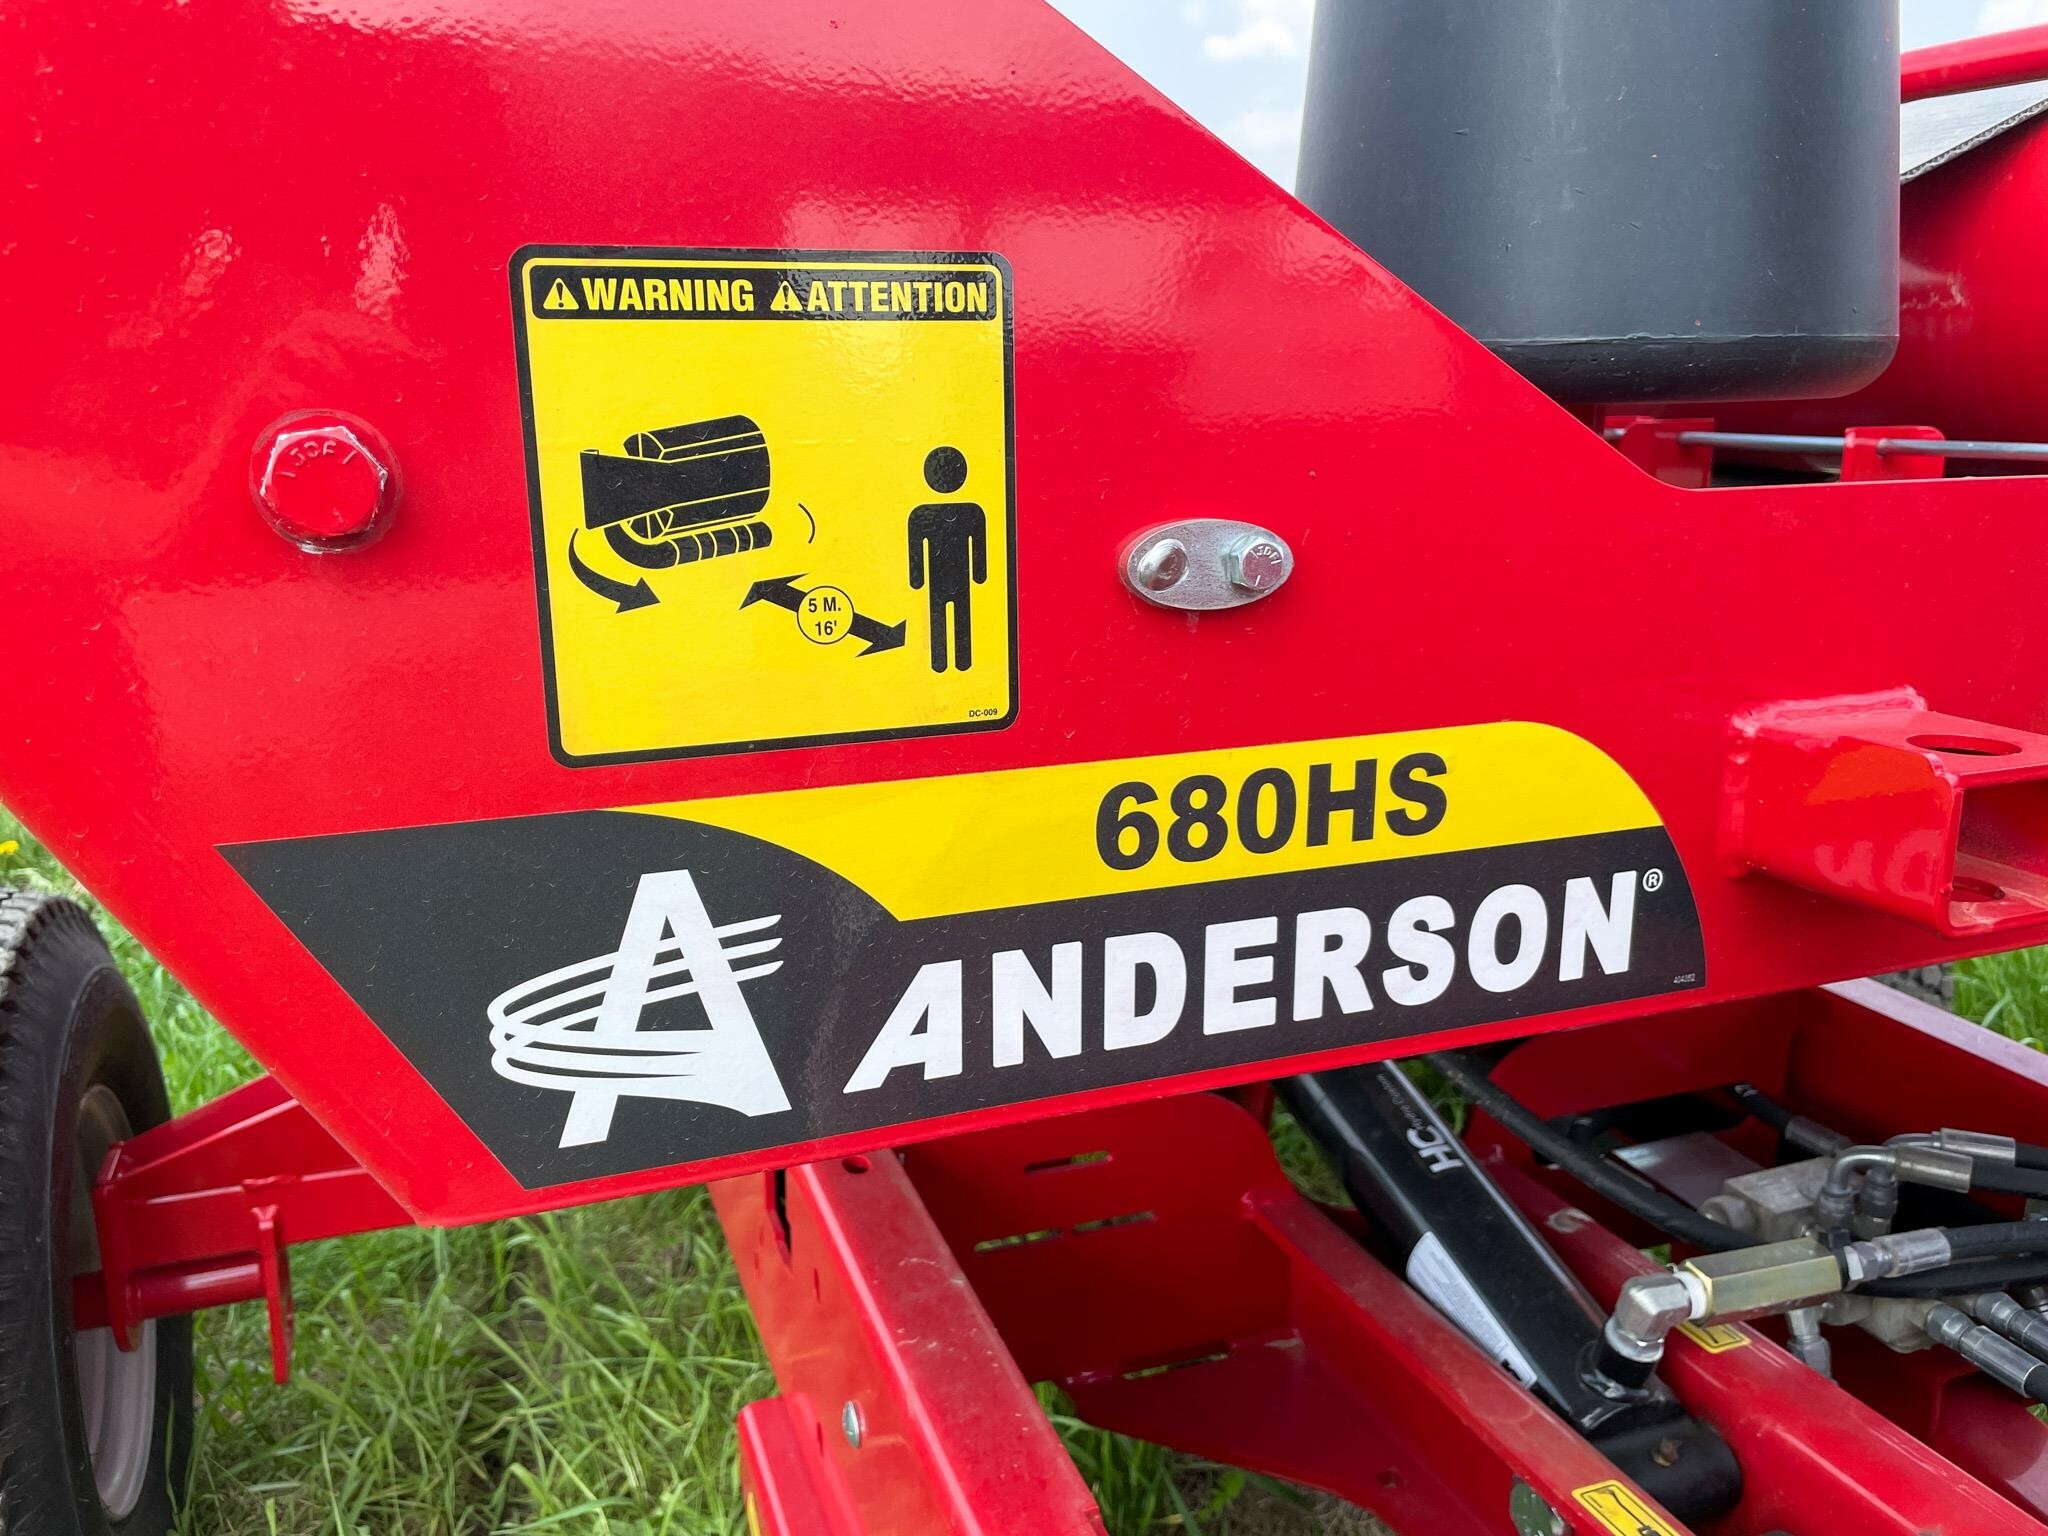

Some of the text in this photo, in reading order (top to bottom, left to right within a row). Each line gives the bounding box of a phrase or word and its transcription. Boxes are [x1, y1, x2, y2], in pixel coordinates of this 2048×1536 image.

[581, 277, 988, 313] WARNING ATTENTION
[808, 596, 841, 613] 5 M.
[815, 620, 837, 636] 16'
[968, 708, 998, 718] DC-009
[1095, 752, 1449, 871] 680HS
[1406, 1125, 1464, 1173] HC
